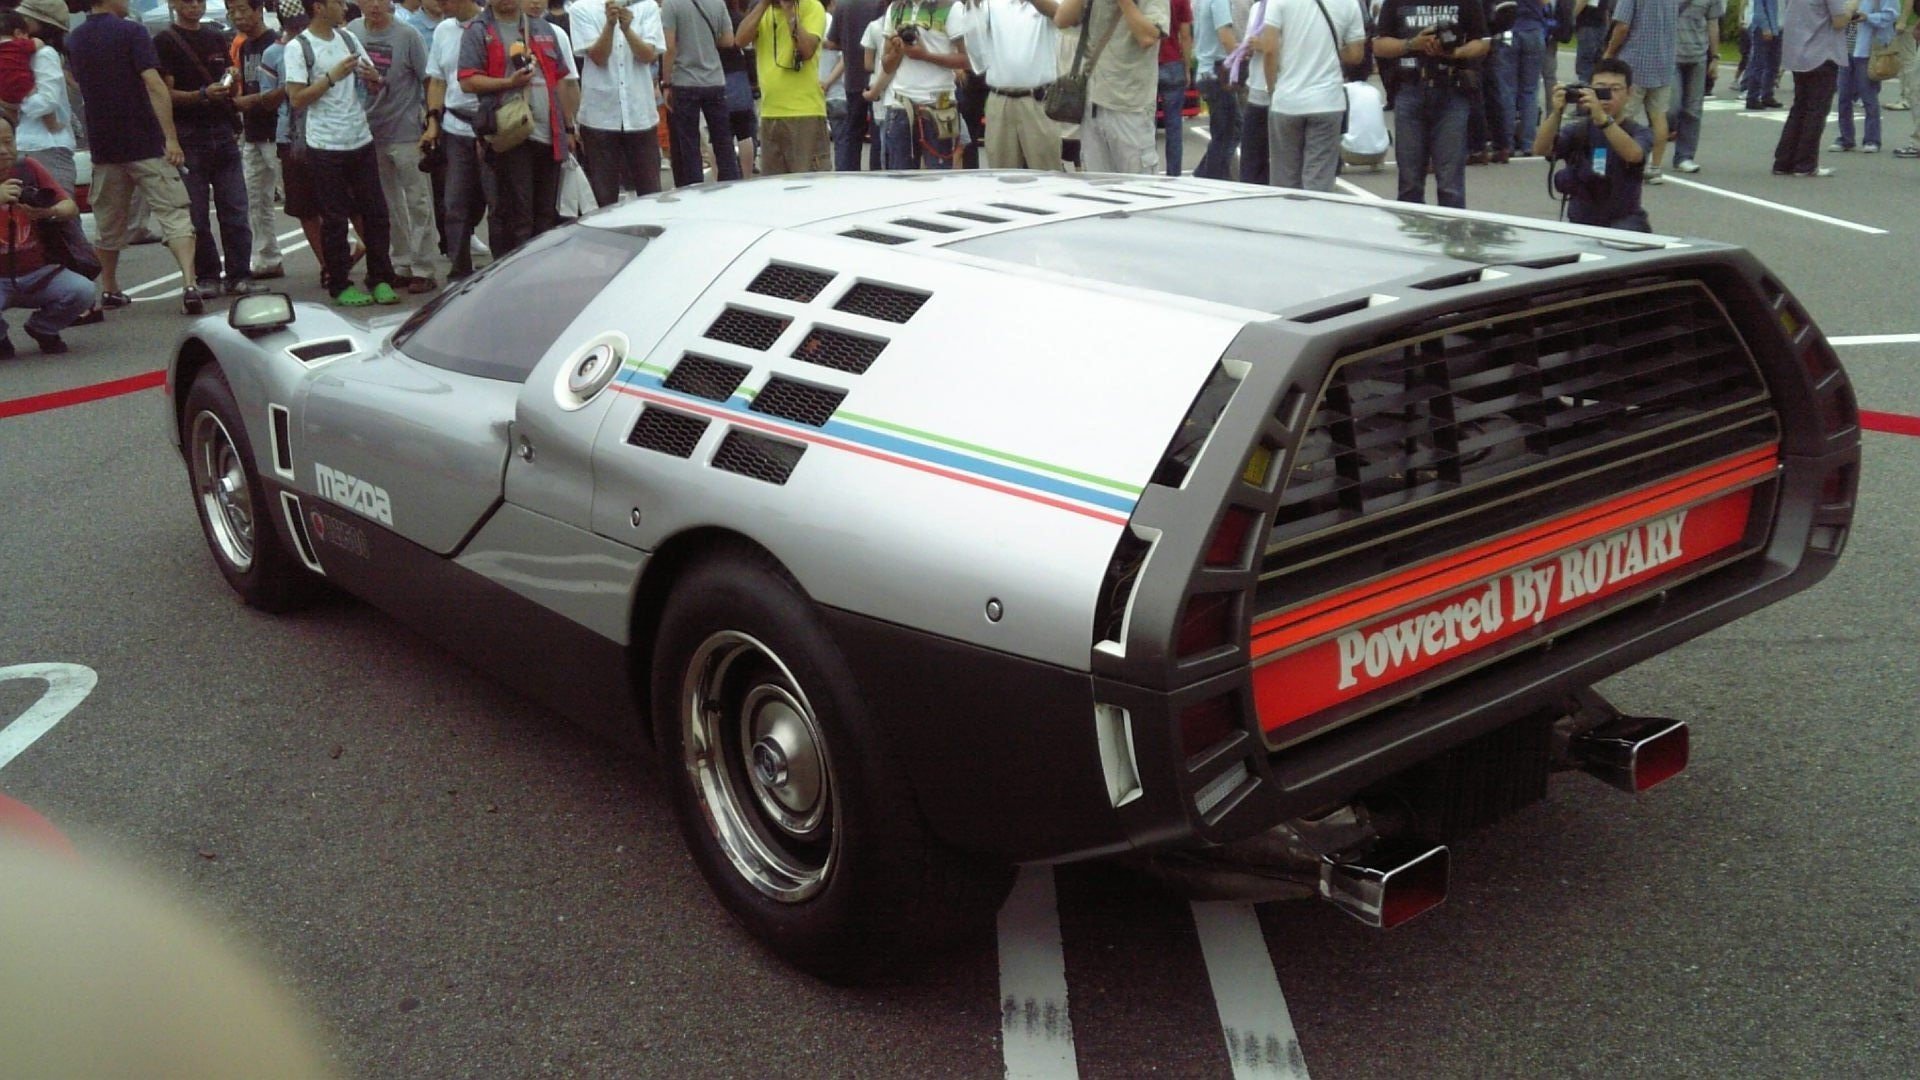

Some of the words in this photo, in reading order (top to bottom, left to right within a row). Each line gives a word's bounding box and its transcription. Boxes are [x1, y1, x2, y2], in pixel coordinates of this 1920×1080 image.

[315, 463, 393, 527] mazda
[1337, 578, 1504, 690] Powered
[1511, 566, 1556, 625] By
[1559, 510, 1689, 603] ROTARY
